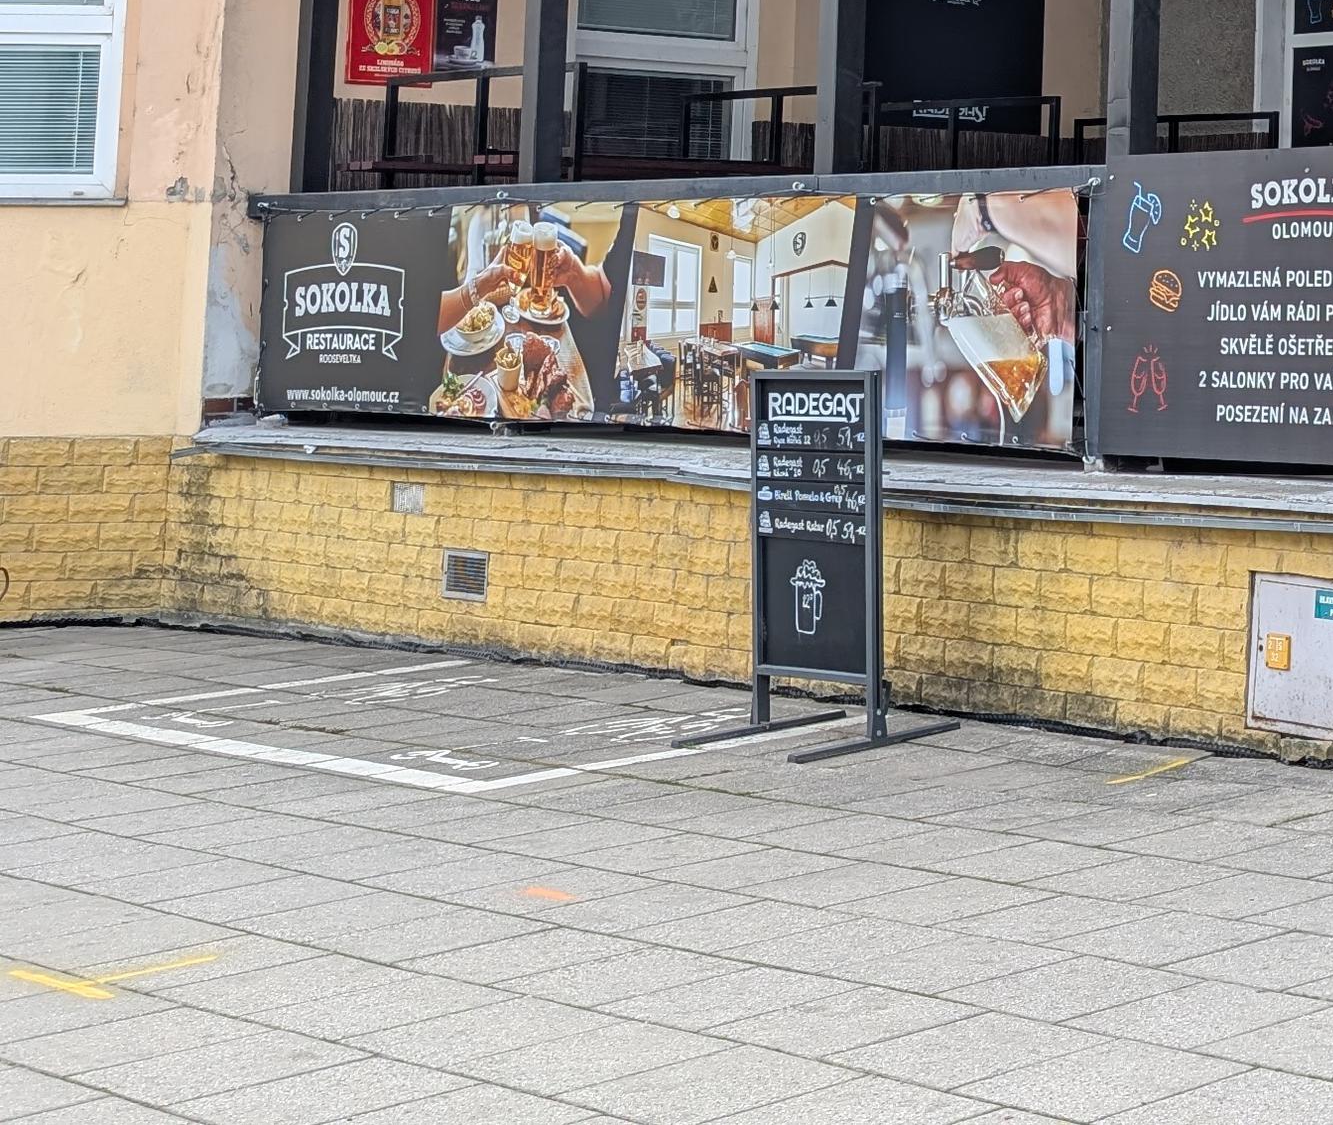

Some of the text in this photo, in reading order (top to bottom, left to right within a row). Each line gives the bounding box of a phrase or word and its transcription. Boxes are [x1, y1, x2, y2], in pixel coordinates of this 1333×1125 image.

[338, 227, 350, 258] S
[1198, 267, 1282, 288] VYMAZLENÁ
[295, 281, 391, 317] SOKOLKA
[1207, 300, 1247, 321] JÍDLO
[1251, 300, 1282, 321] VÁM
[1286, 300, 1320, 322] RÁDI
[306, 333, 376, 350] RESTAURACE
[1220, 334, 1274, 355] SKVĚLĚ
[319, 353, 361, 364] ROOSEVELTKA
[1199, 371, 1207, 387] 2
[1211, 371, 1276, 390] SALONKY
[1280, 372, 1309, 390] PRO
[286, 386, 399, 404] www.sokolka-olomouc.cz
[768, 392, 864, 423] RADEGAST
[1216, 403, 1285, 423] POSEZENÍ
[1289, 406, 1309, 424] NA
[773, 423, 803, 436] Radegast
[803, 435, 811, 445] 12
[773, 455, 803, 472] Radegast
[793, 469, 802, 477] 10
[774, 517, 804, 533] Radegast
